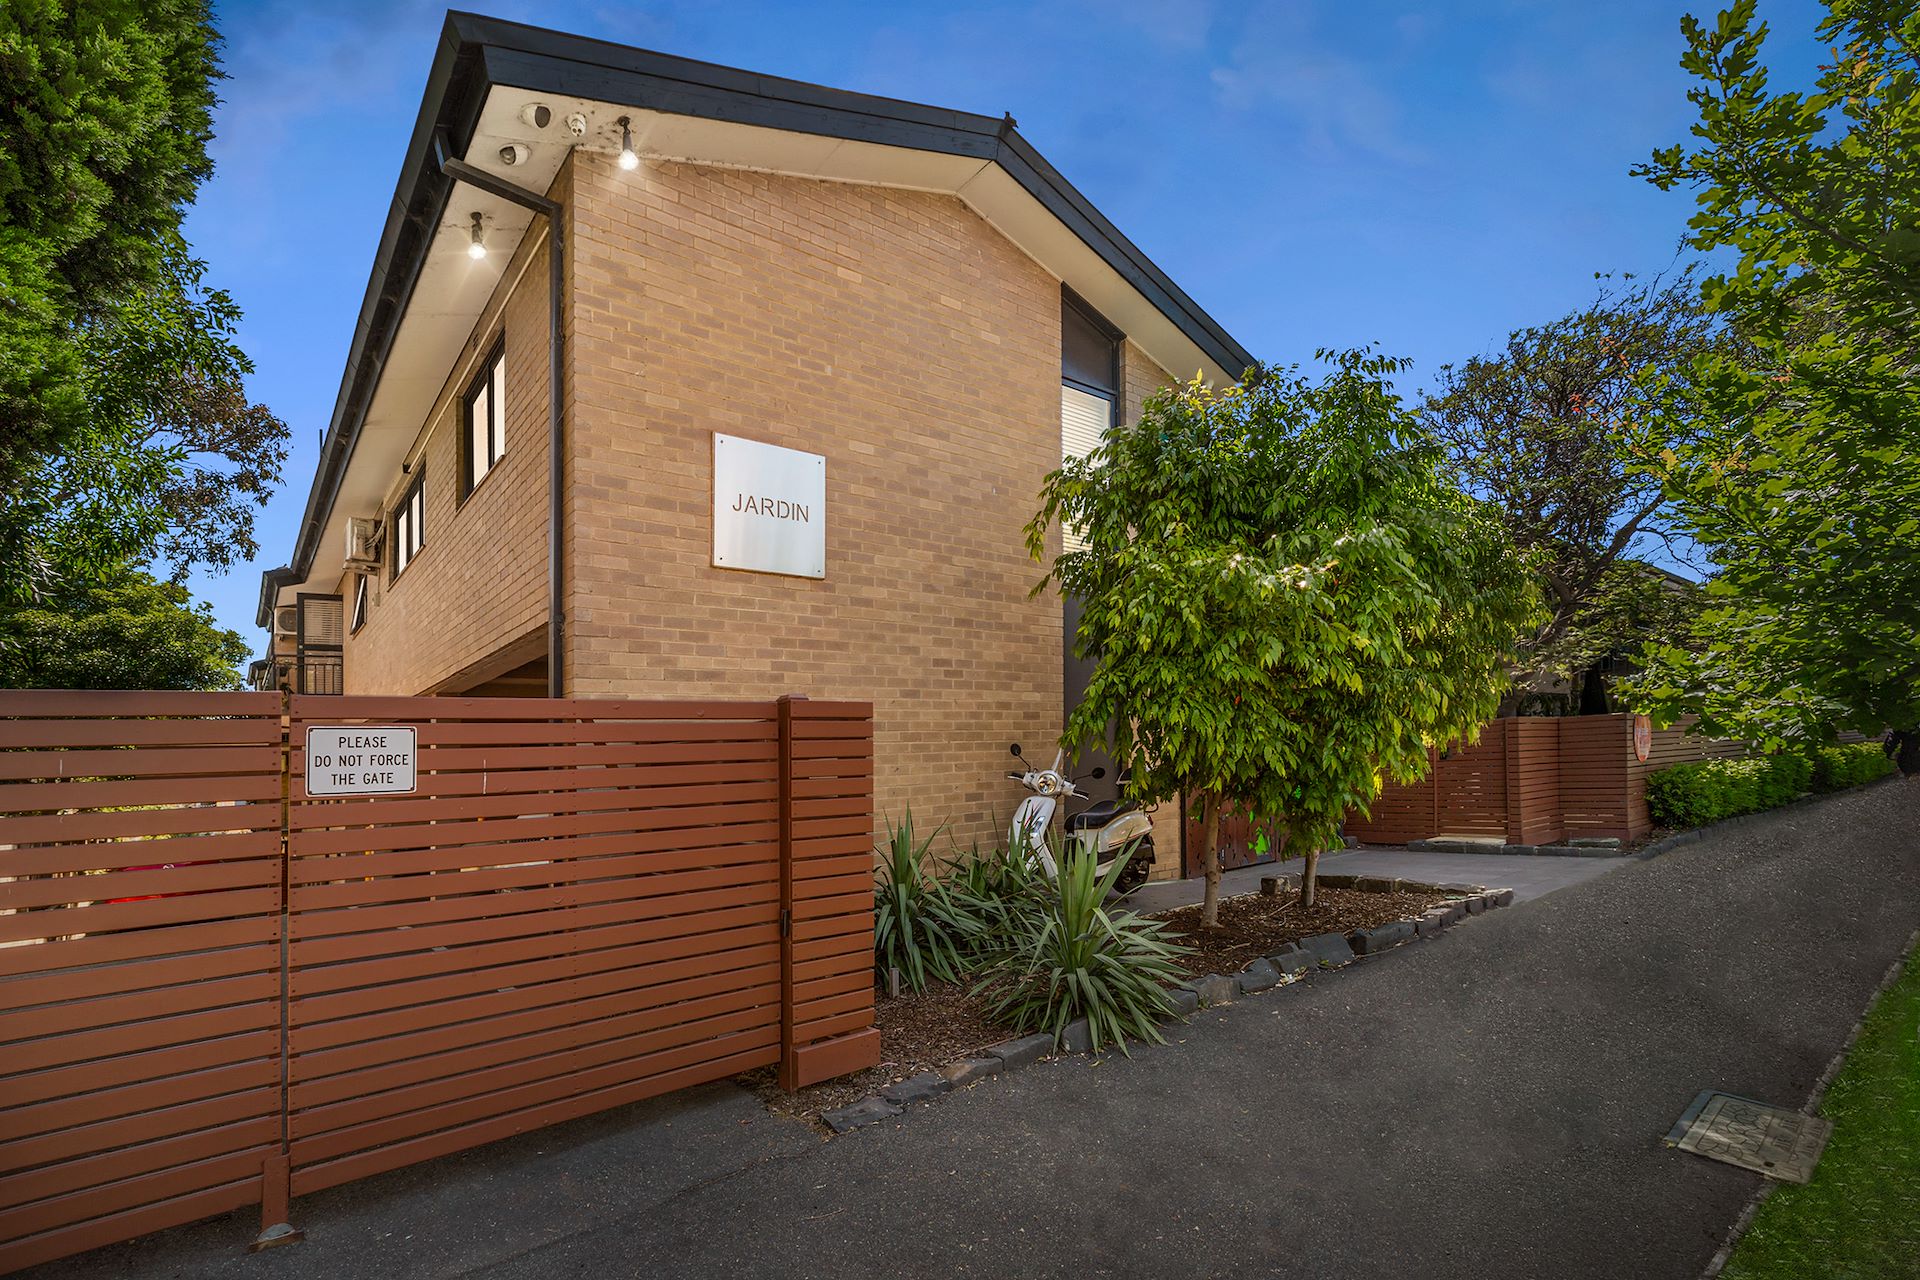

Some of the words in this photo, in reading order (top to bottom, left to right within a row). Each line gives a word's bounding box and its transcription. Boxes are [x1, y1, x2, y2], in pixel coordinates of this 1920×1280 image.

[732, 493, 809, 523] JARDIN
[338, 736, 387, 748] PLEASE
[315, 755, 332, 767] DO
[339, 755, 363, 767] NOT
[370, 754, 409, 766] FORCE
[331, 773, 356, 785] THE
[363, 772, 394, 784] GATE
